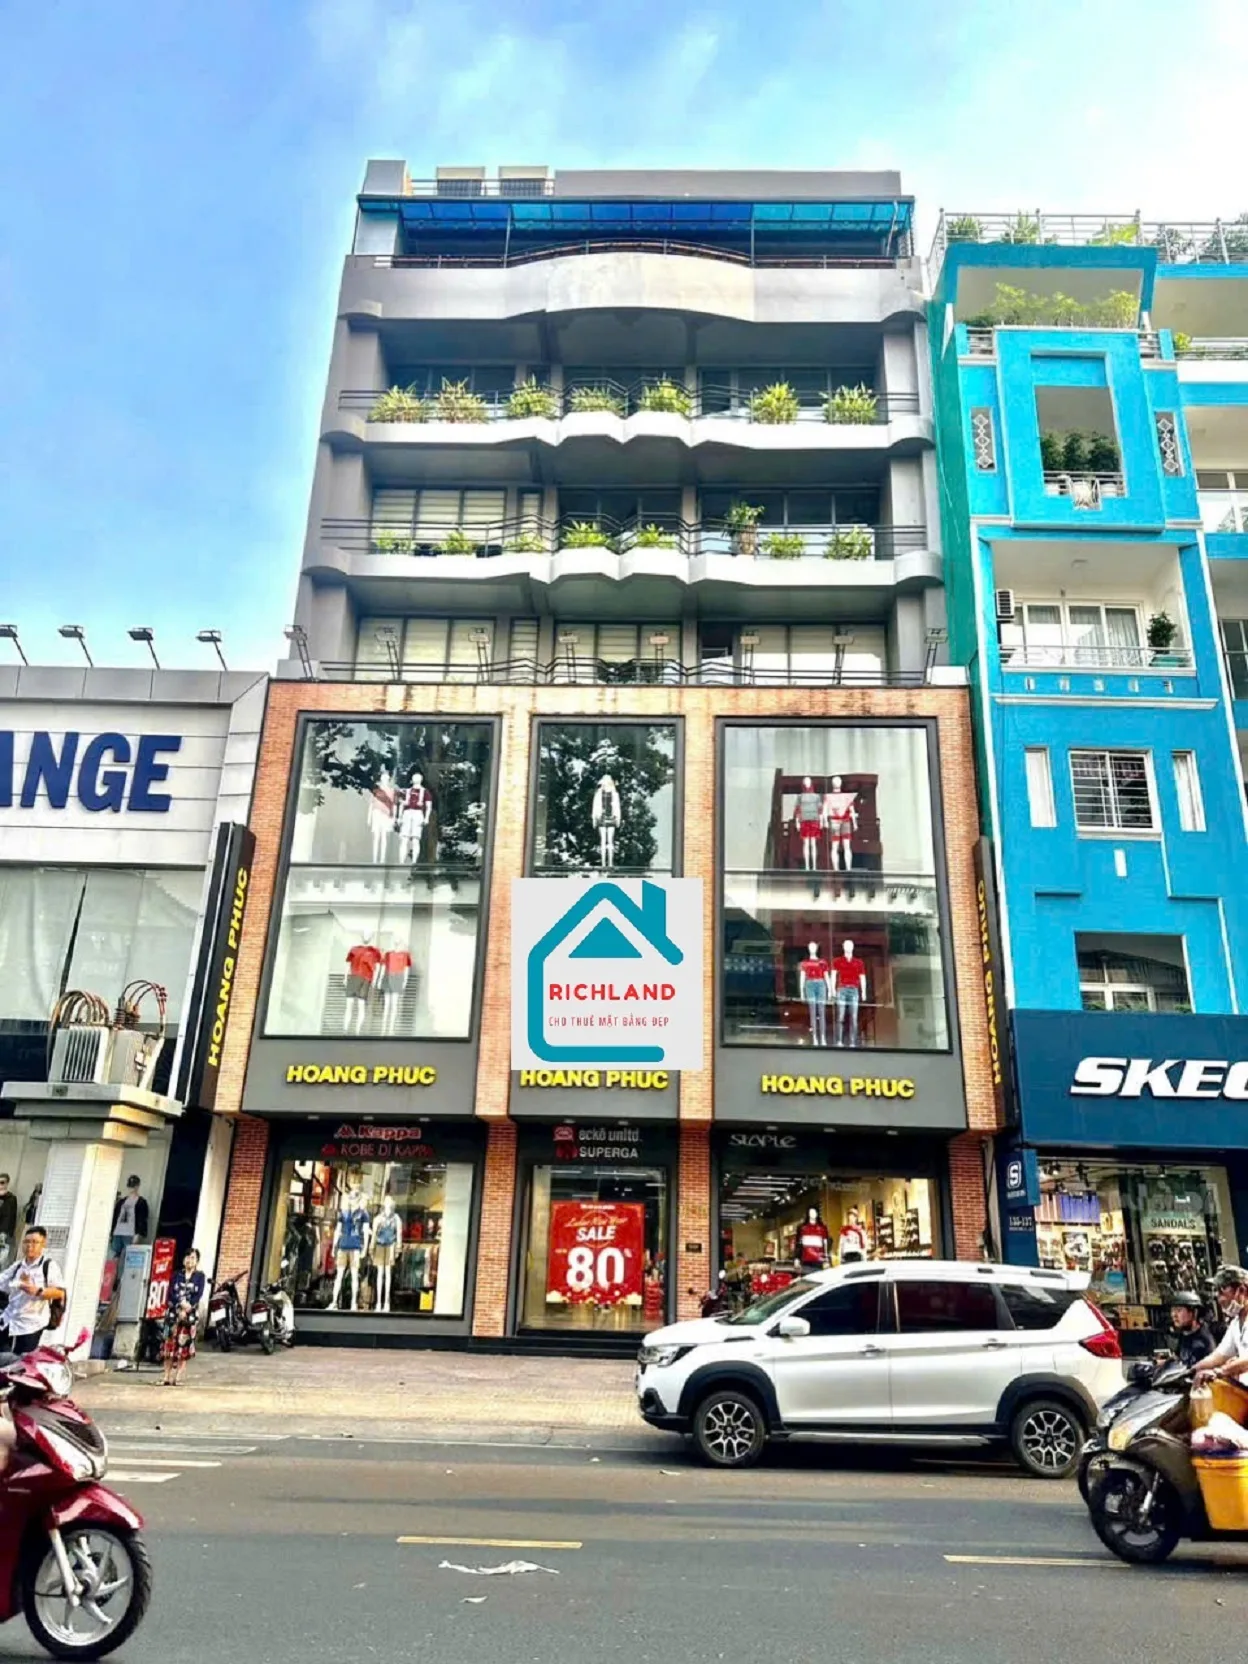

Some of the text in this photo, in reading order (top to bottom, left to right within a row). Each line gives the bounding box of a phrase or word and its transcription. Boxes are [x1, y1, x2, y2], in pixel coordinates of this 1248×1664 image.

[207, 867, 249, 1067] HOANG PHUC
[286, 1064, 437, 1085] HOANG PHUC
[519, 1070, 669, 1089] HOANG PHUC
[761, 1074, 916, 1098] HOANG PHUC
[358, 1125, 421, 1140] Kappa
[579, 1146, 639, 1158] SUPERGA
[1151, 1218, 1197, 1229] SANDALS
[576, 1226, 616, 1242] SALE
